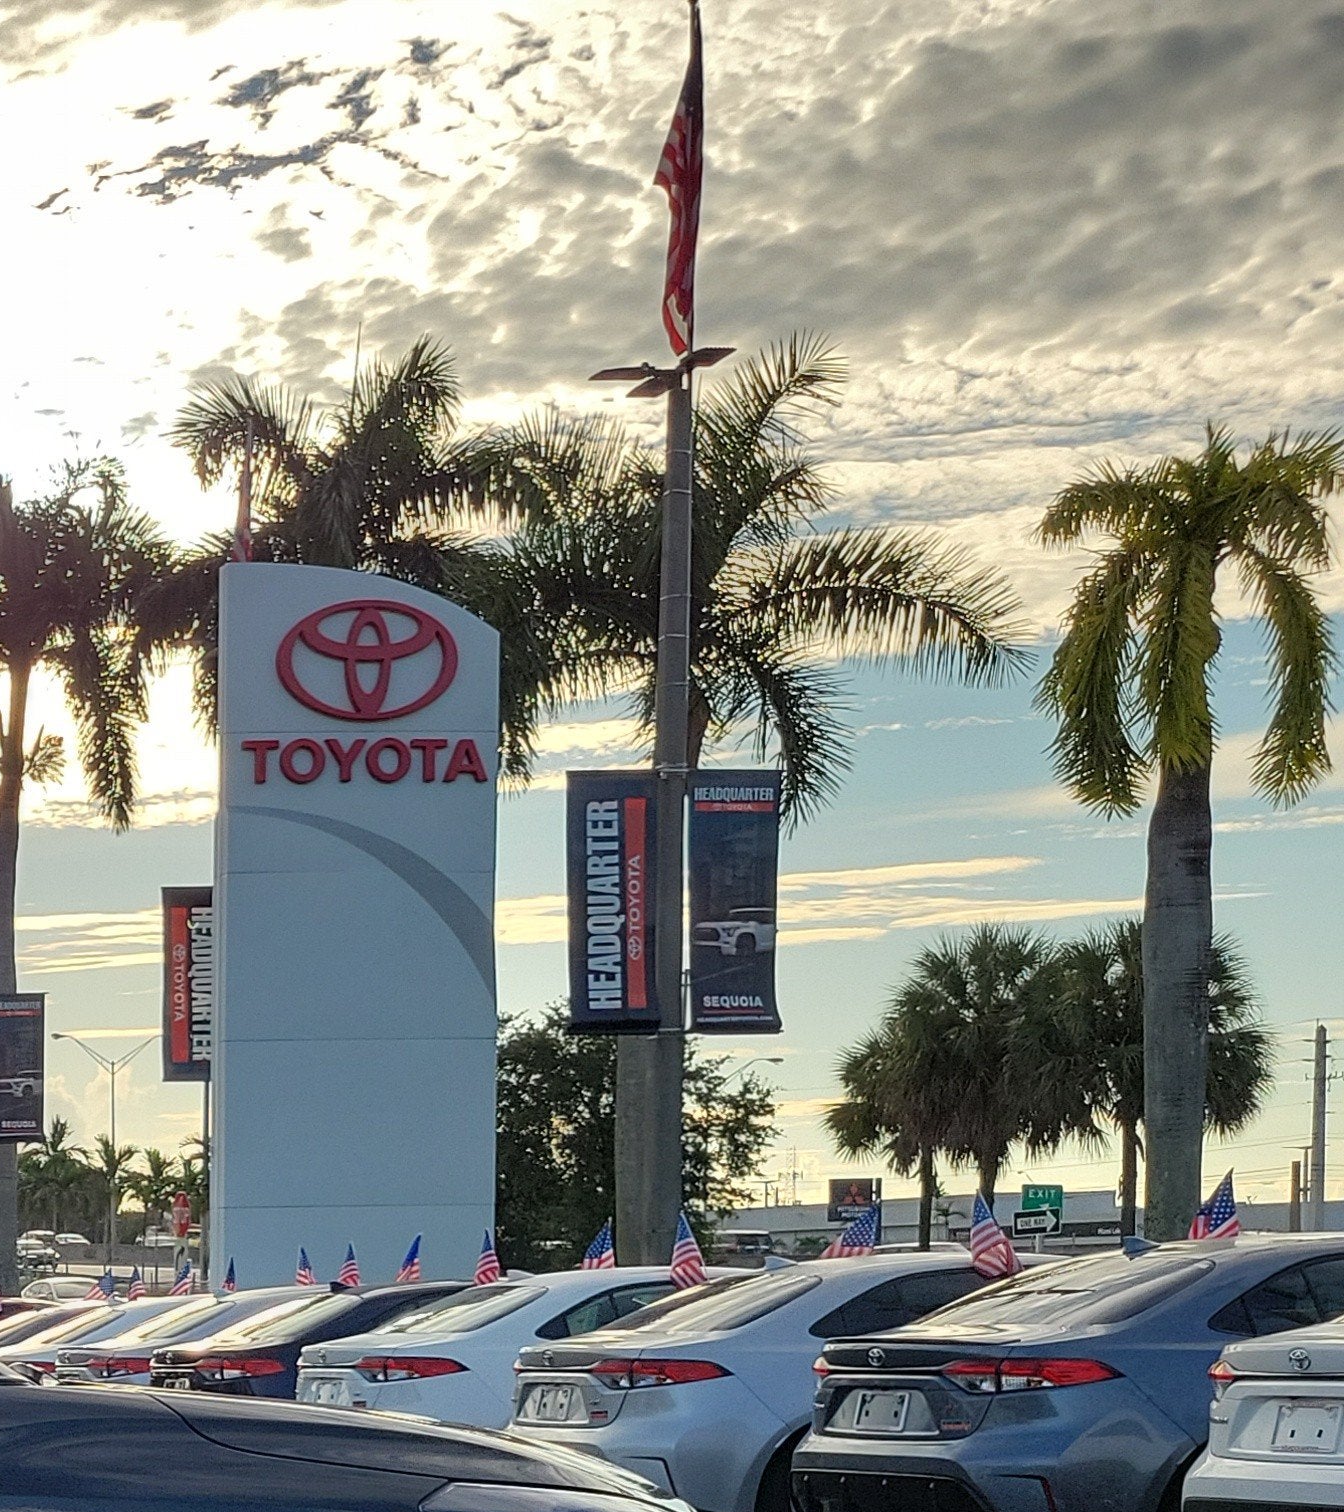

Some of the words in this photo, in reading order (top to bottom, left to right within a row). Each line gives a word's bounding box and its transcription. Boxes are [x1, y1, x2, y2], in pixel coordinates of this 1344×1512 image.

[241, 738, 488, 784] TOYOTA
[694, 787, 774, 802] HEADQUARTER
[586, 800, 626, 1010] HEADQUARTER
[627, 855, 641, 934] TOYOTA
[173, 966, 186, 1022] TOYOTA
[703, 995, 764, 1009] SEQUOIA
[1028, 1188, 1056, 1199] EXIT
